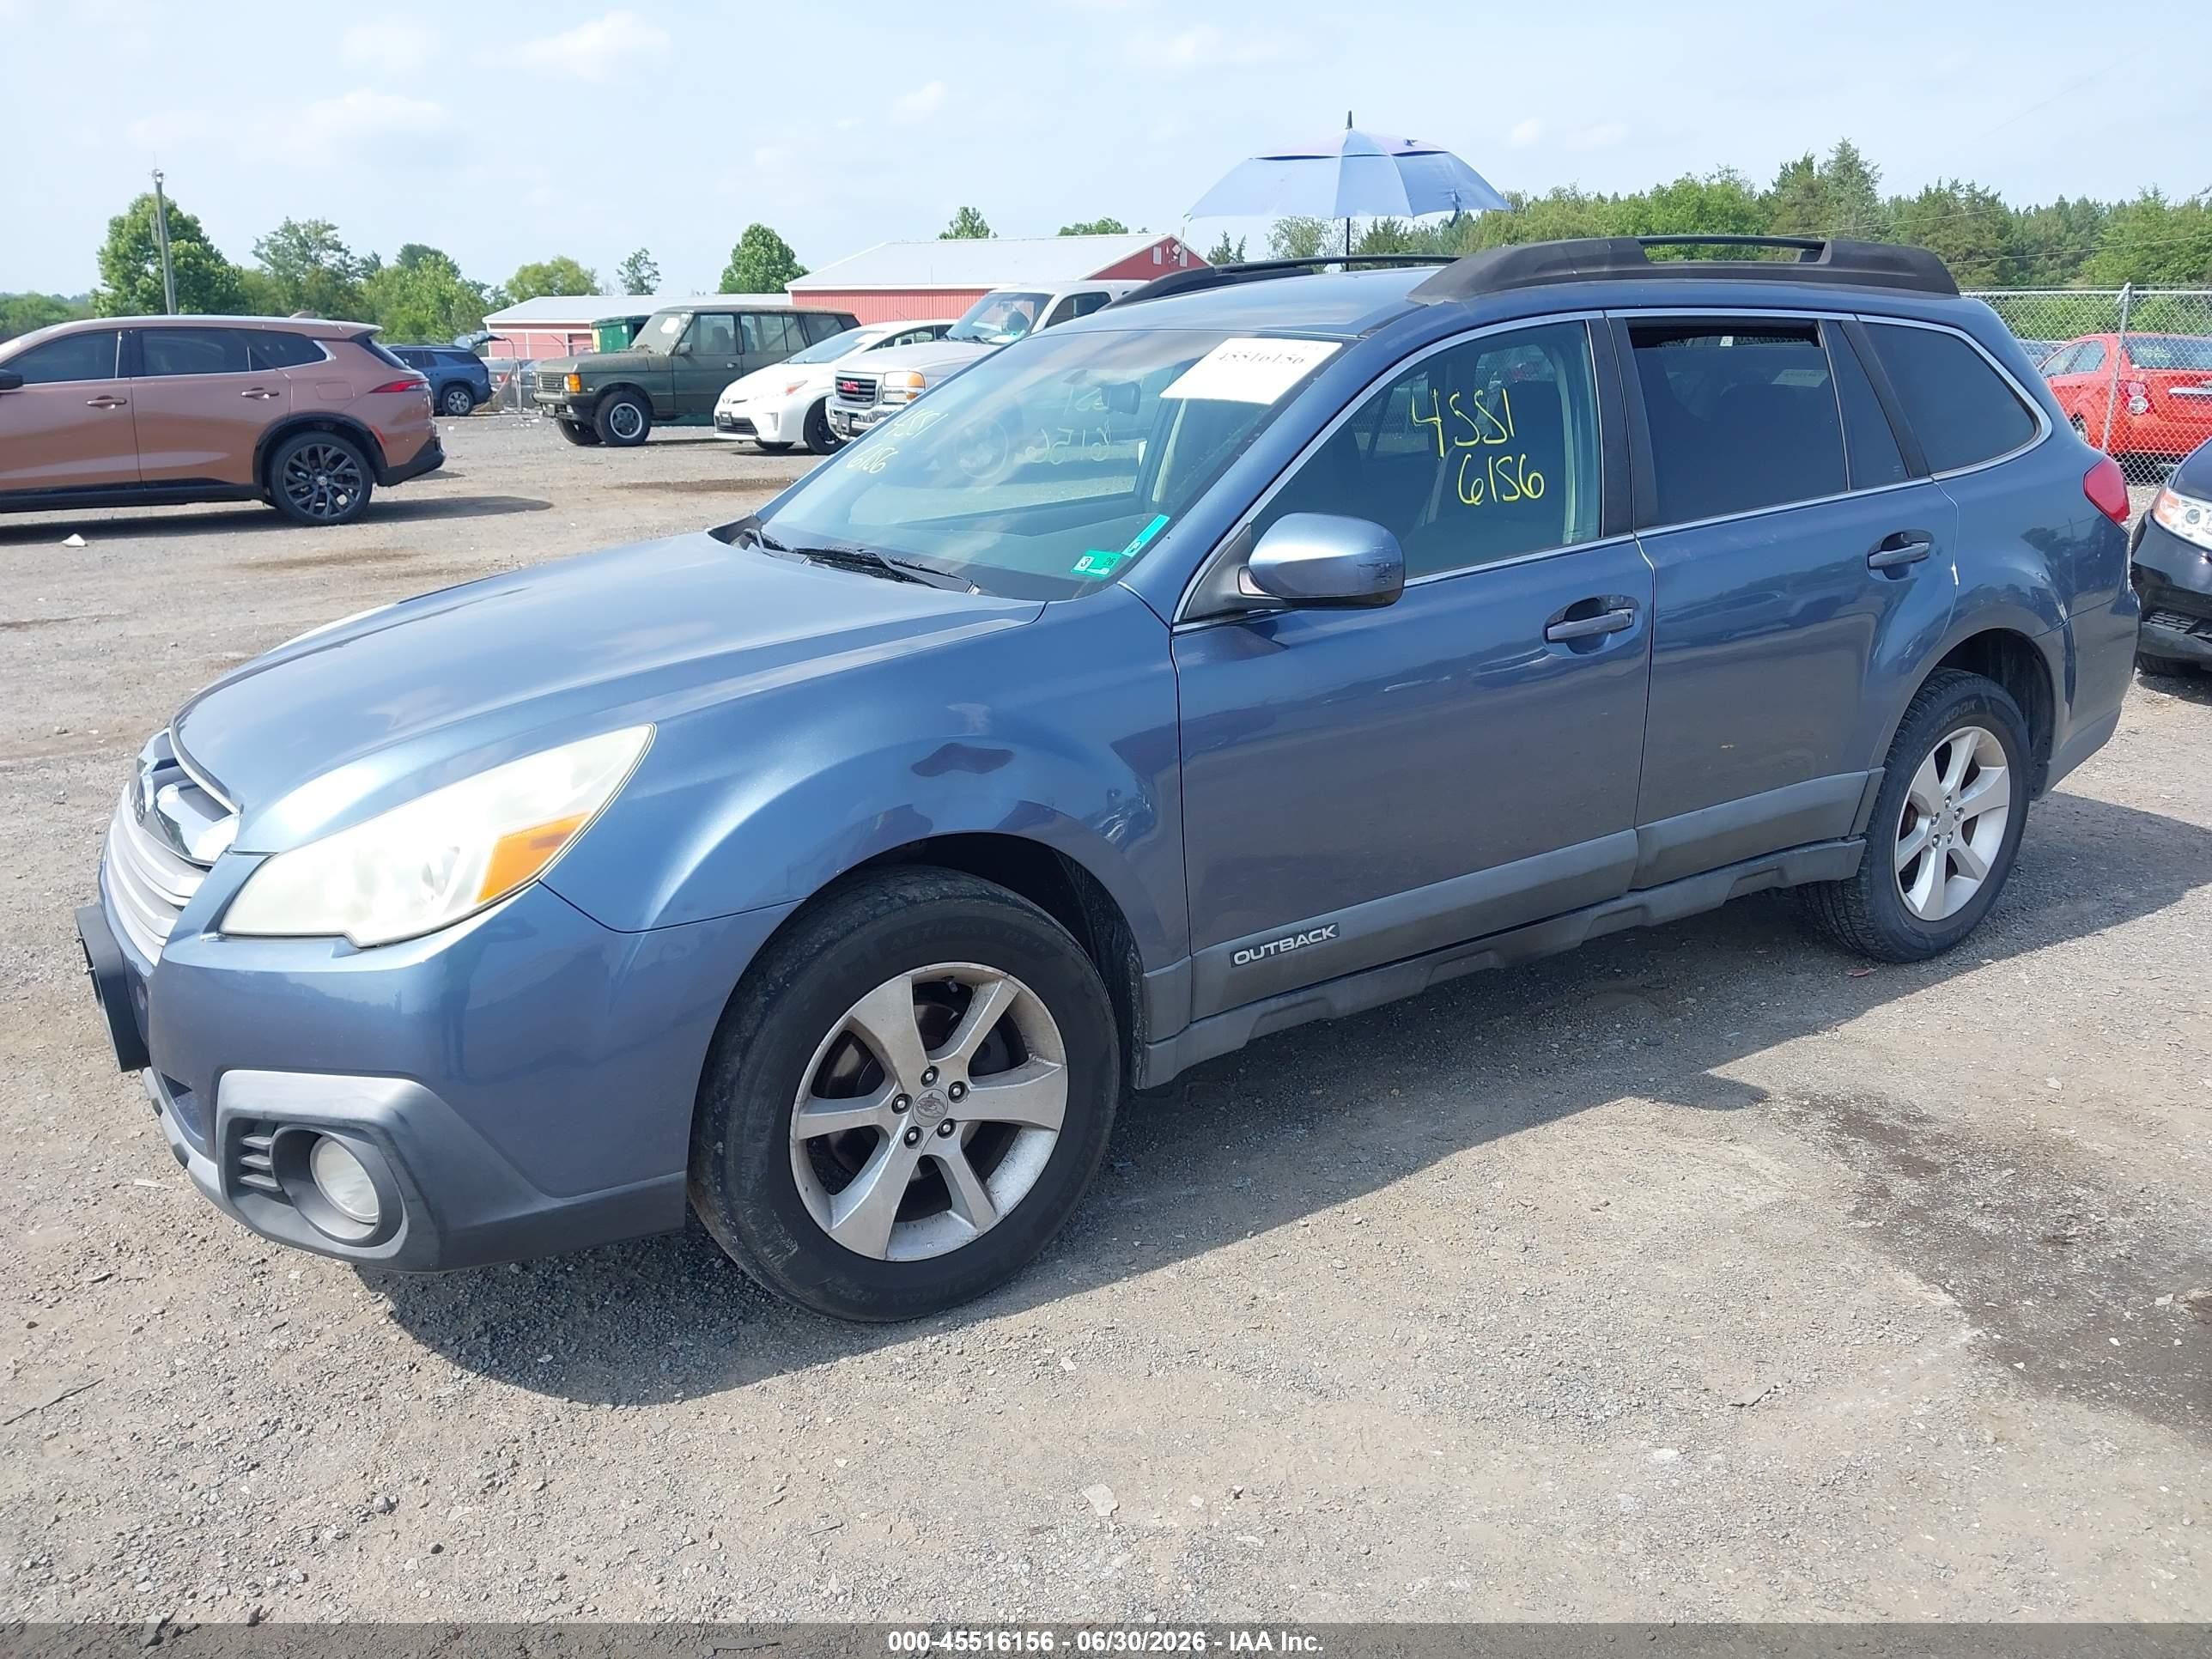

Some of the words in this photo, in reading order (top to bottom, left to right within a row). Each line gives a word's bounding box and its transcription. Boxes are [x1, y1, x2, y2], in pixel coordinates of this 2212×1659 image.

[1411, 388, 1516, 459] 4551
[1457, 453, 1545, 505] 6156
[1234, 925, 1337, 965] OUTBACK
